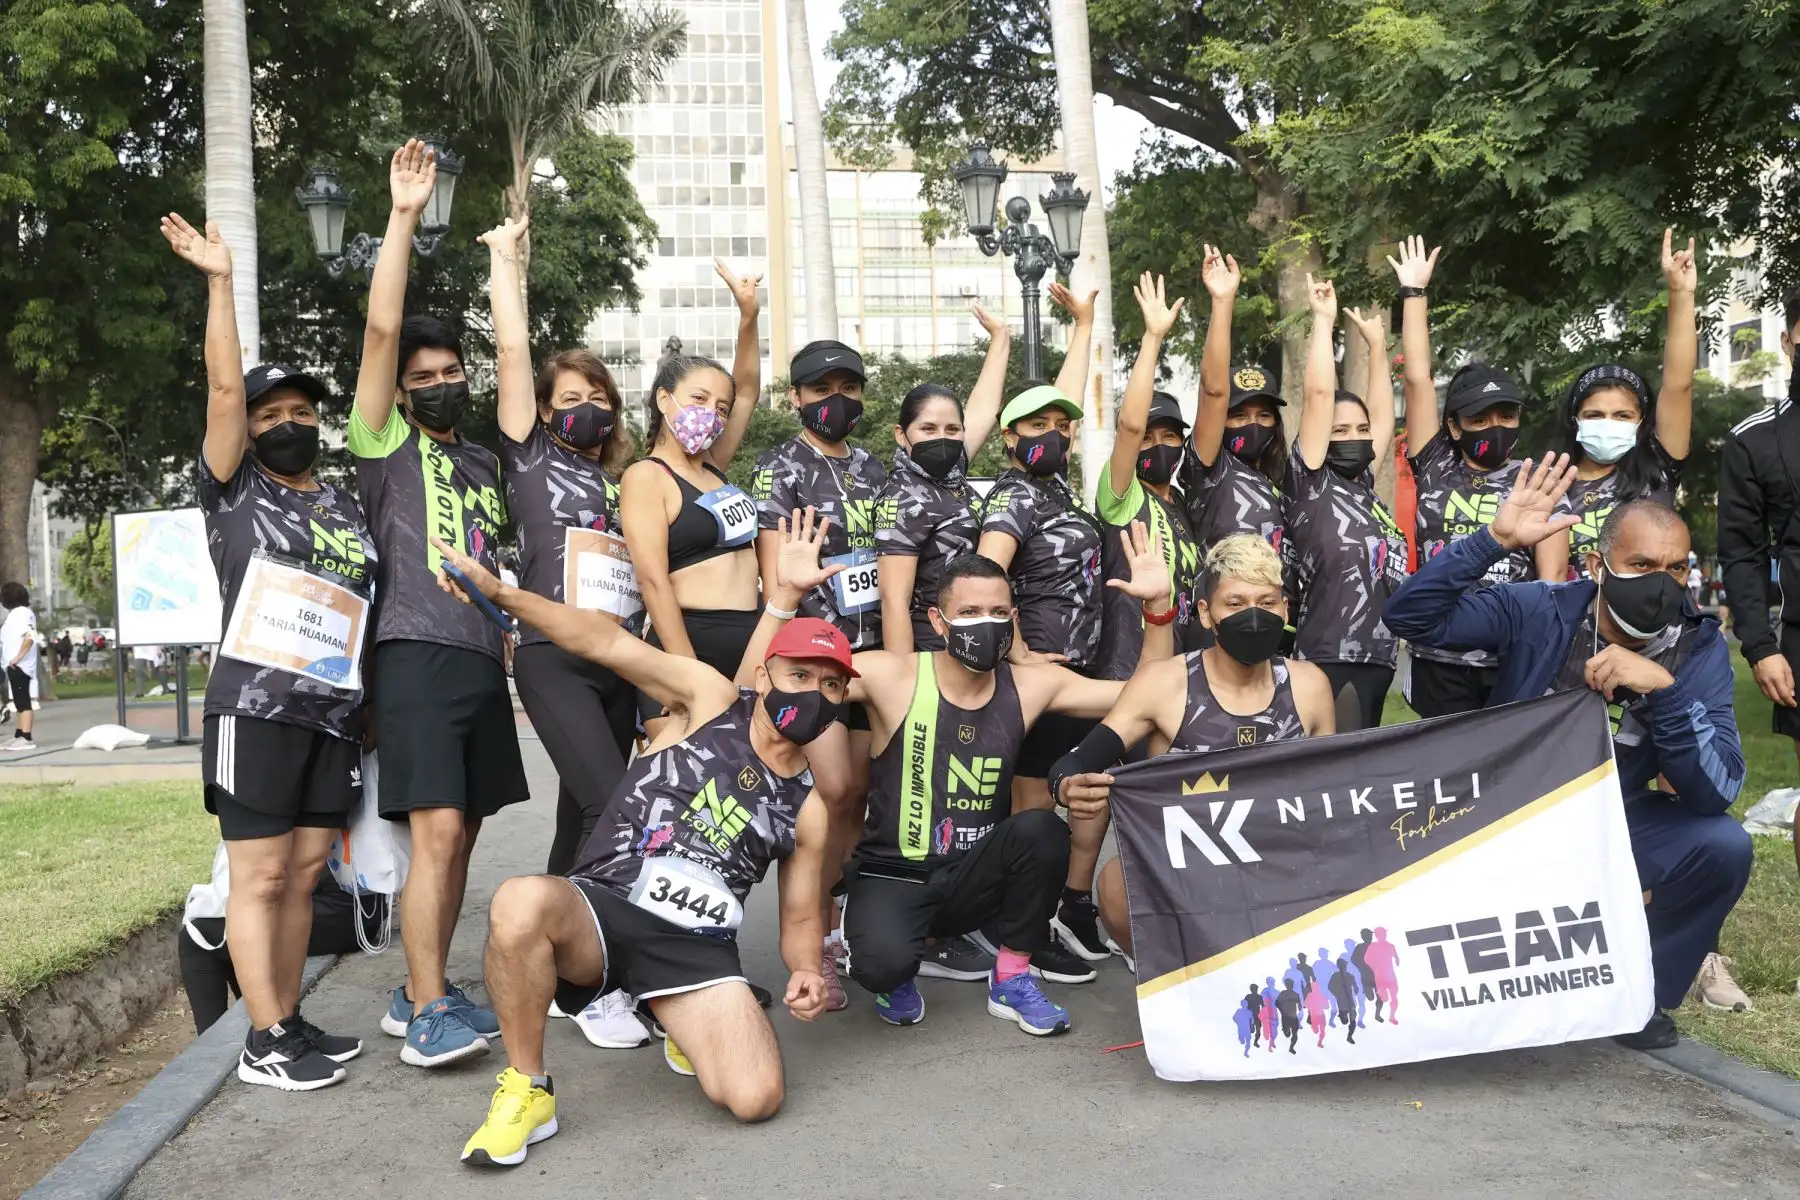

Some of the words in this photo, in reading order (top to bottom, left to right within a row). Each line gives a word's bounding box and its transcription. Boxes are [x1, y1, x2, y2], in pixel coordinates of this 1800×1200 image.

[722, 499, 756, 527] 6070
[311, 553, 364, 580] I-ONE
[610, 567, 632, 583] 1679
[580, 577, 617, 593] YLIANA
[296, 609, 323, 627] 1681
[955, 647, 978, 663] MARIO
[910, 722, 928, 798] IMPOSIBLE
[909, 800, 924, 820] LO
[946, 797, 994, 811] I-ONE
[1276, 772, 1481, 824] NIKELI
[680, 810, 731, 853] I-ONE
[907, 820, 922, 850] HAZ
[1390, 804, 1477, 852] Fashion
[649, 876, 729, 926] 3444
[1405, 900, 1609, 979] TEAM
[1421, 982, 1496, 1011] VILLA
[1498, 964, 1615, 1001] RUNNERS
